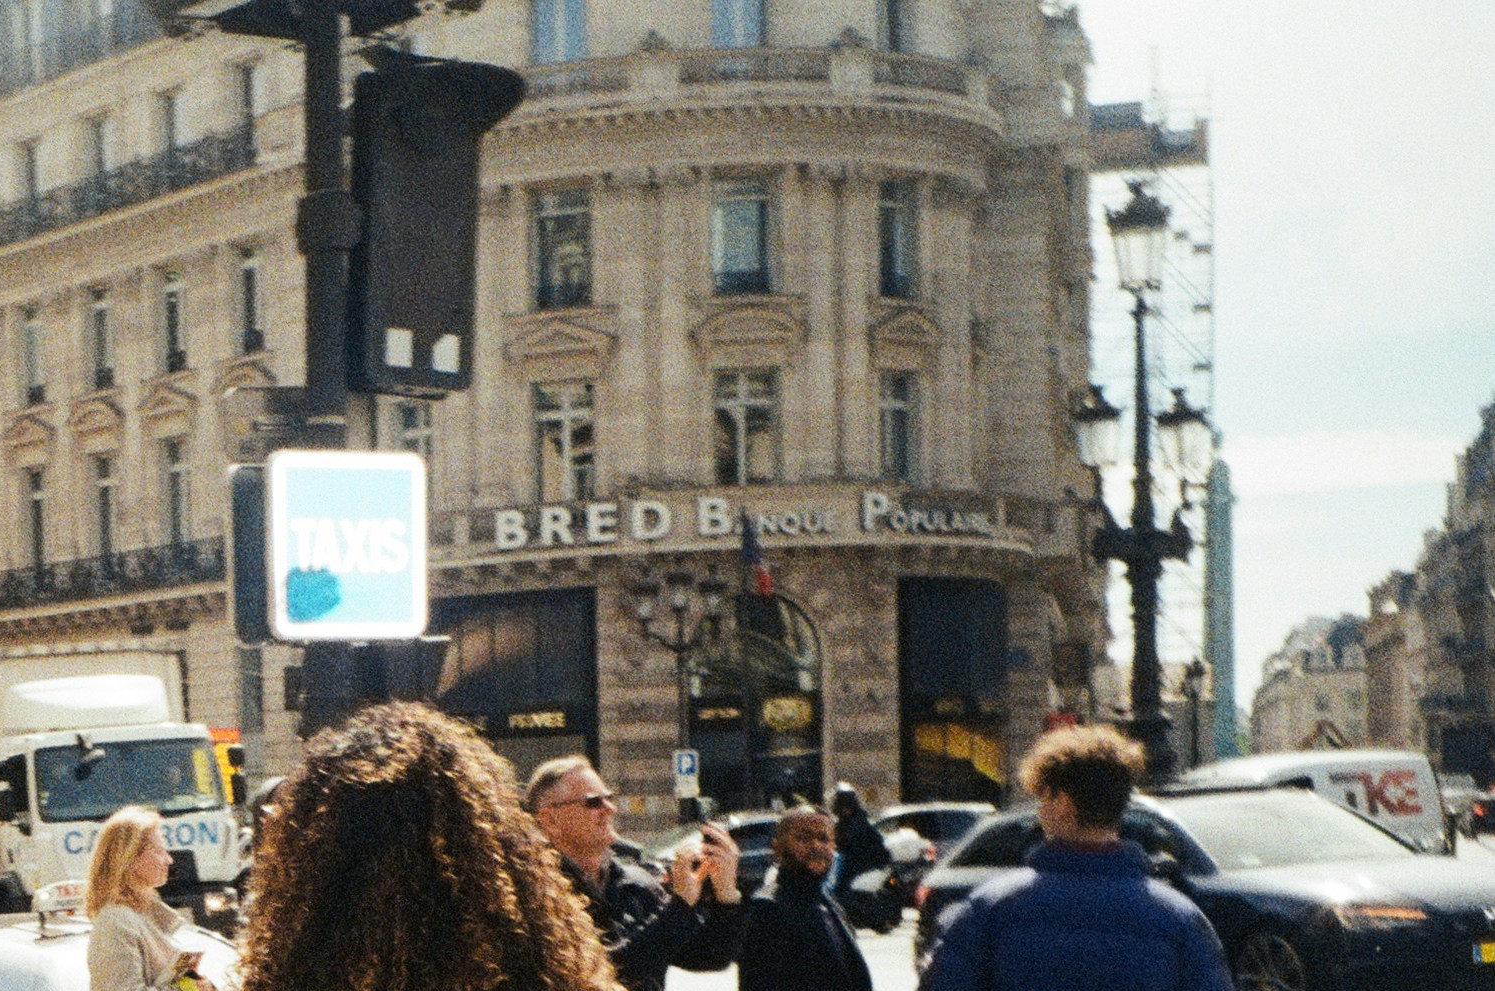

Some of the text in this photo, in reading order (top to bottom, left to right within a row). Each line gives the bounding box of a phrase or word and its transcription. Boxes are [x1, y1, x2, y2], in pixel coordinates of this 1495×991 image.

[291, 517, 410, 573] TAXIS
[494, 500, 671, 549] BRED
[697, 497, 837, 537] BNQUE
